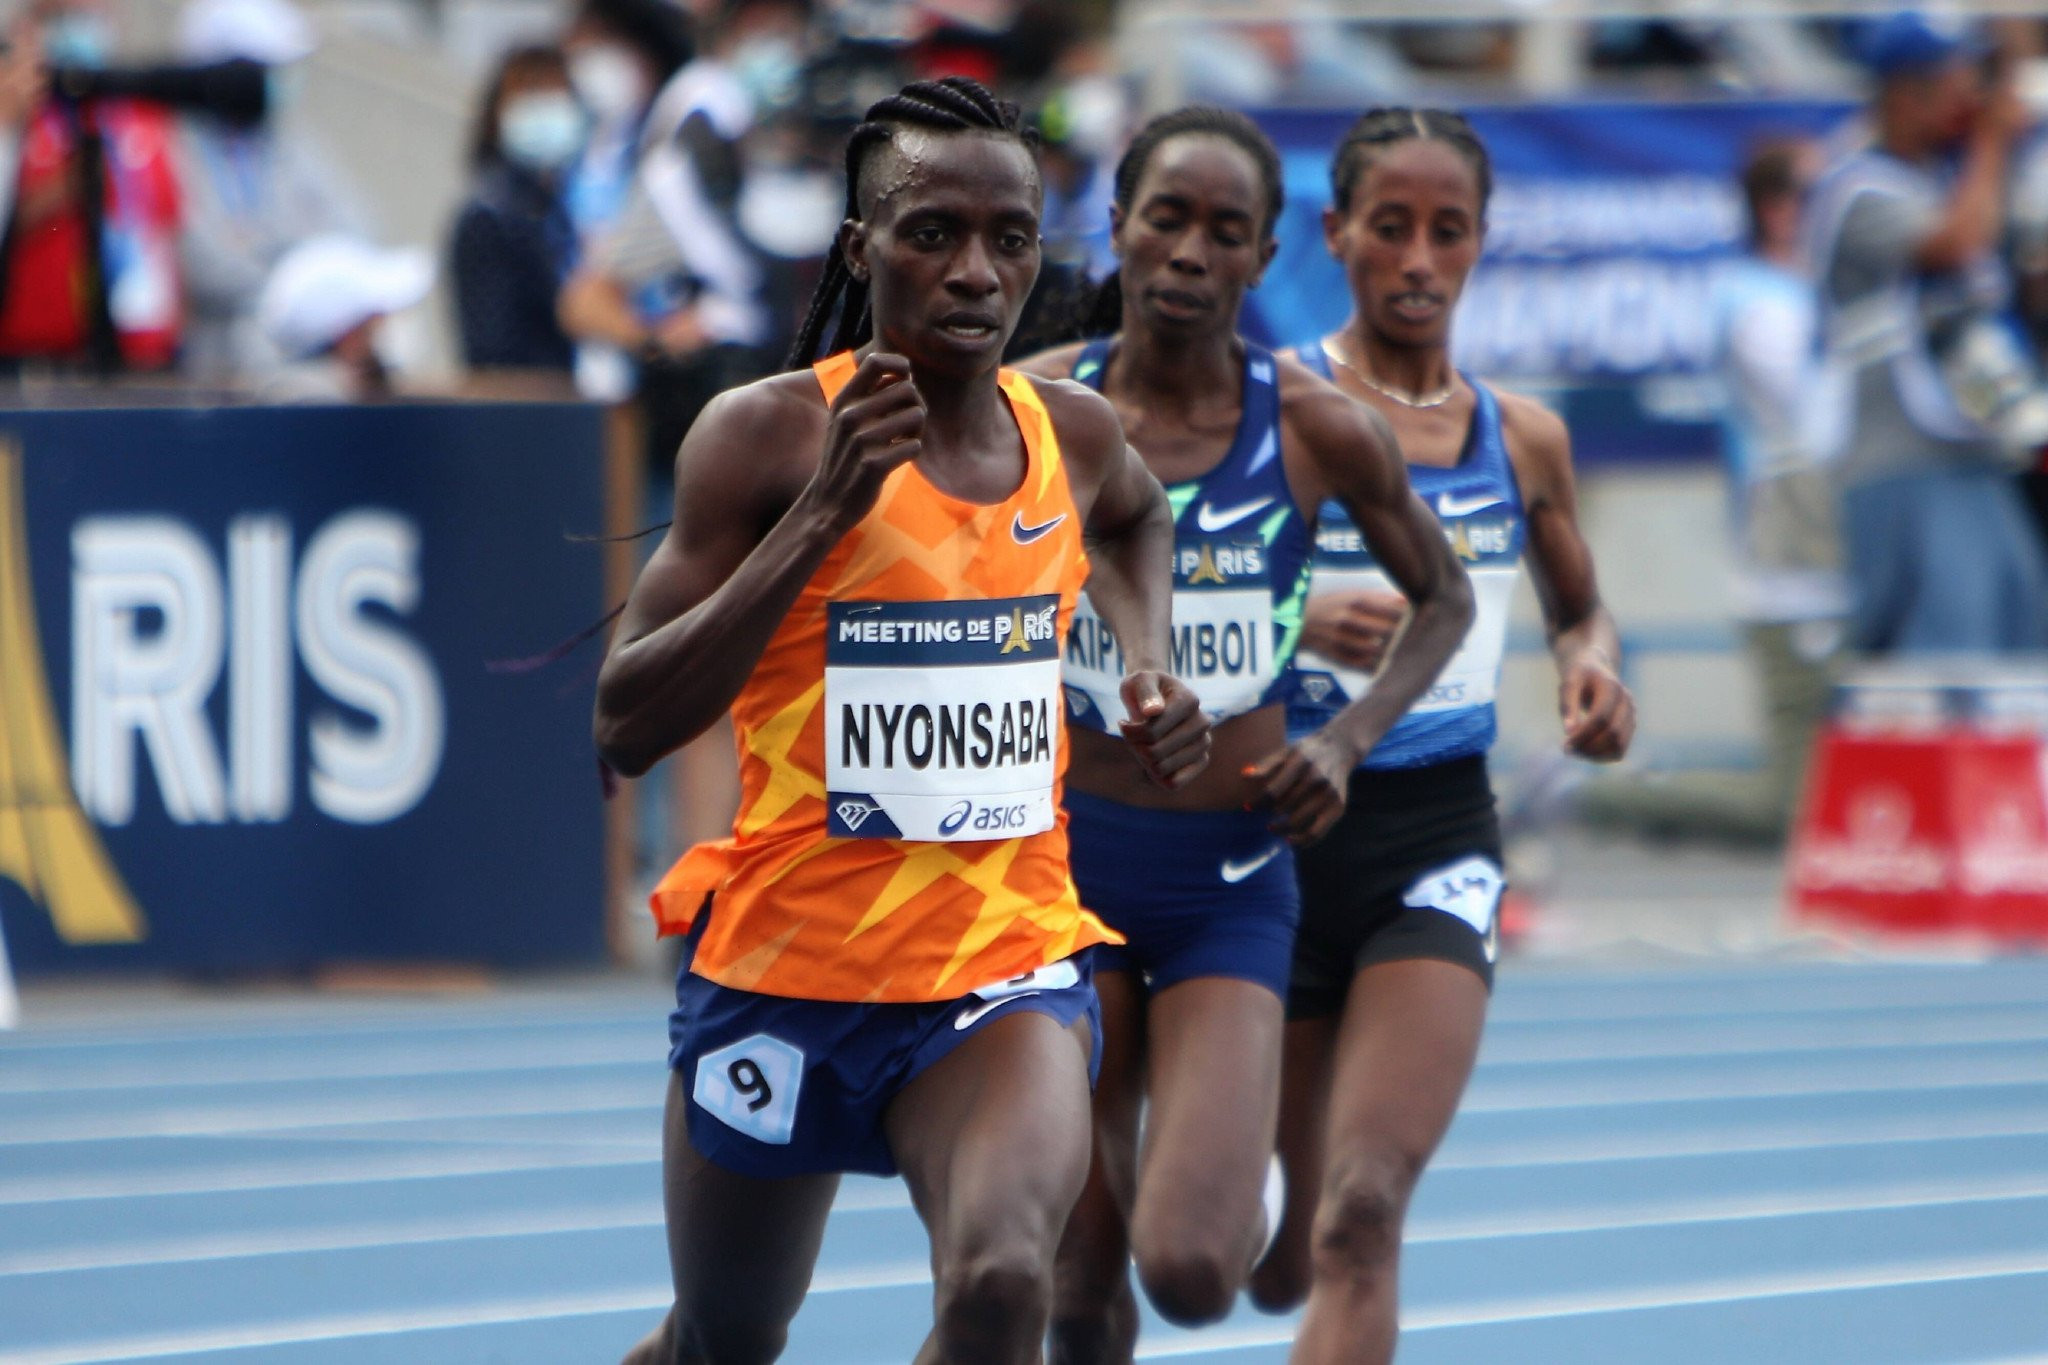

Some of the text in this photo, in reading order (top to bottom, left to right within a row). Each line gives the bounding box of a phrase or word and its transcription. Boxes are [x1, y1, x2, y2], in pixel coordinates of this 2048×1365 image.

[838, 607, 1055, 654] MEETING DE PARIS
[1066, 616, 1258, 678] KIPMBOI
[841, 697, 1050, 770] NYONSABA
[973, 803, 1026, 830] asics
[727, 1057, 772, 1114] 9
